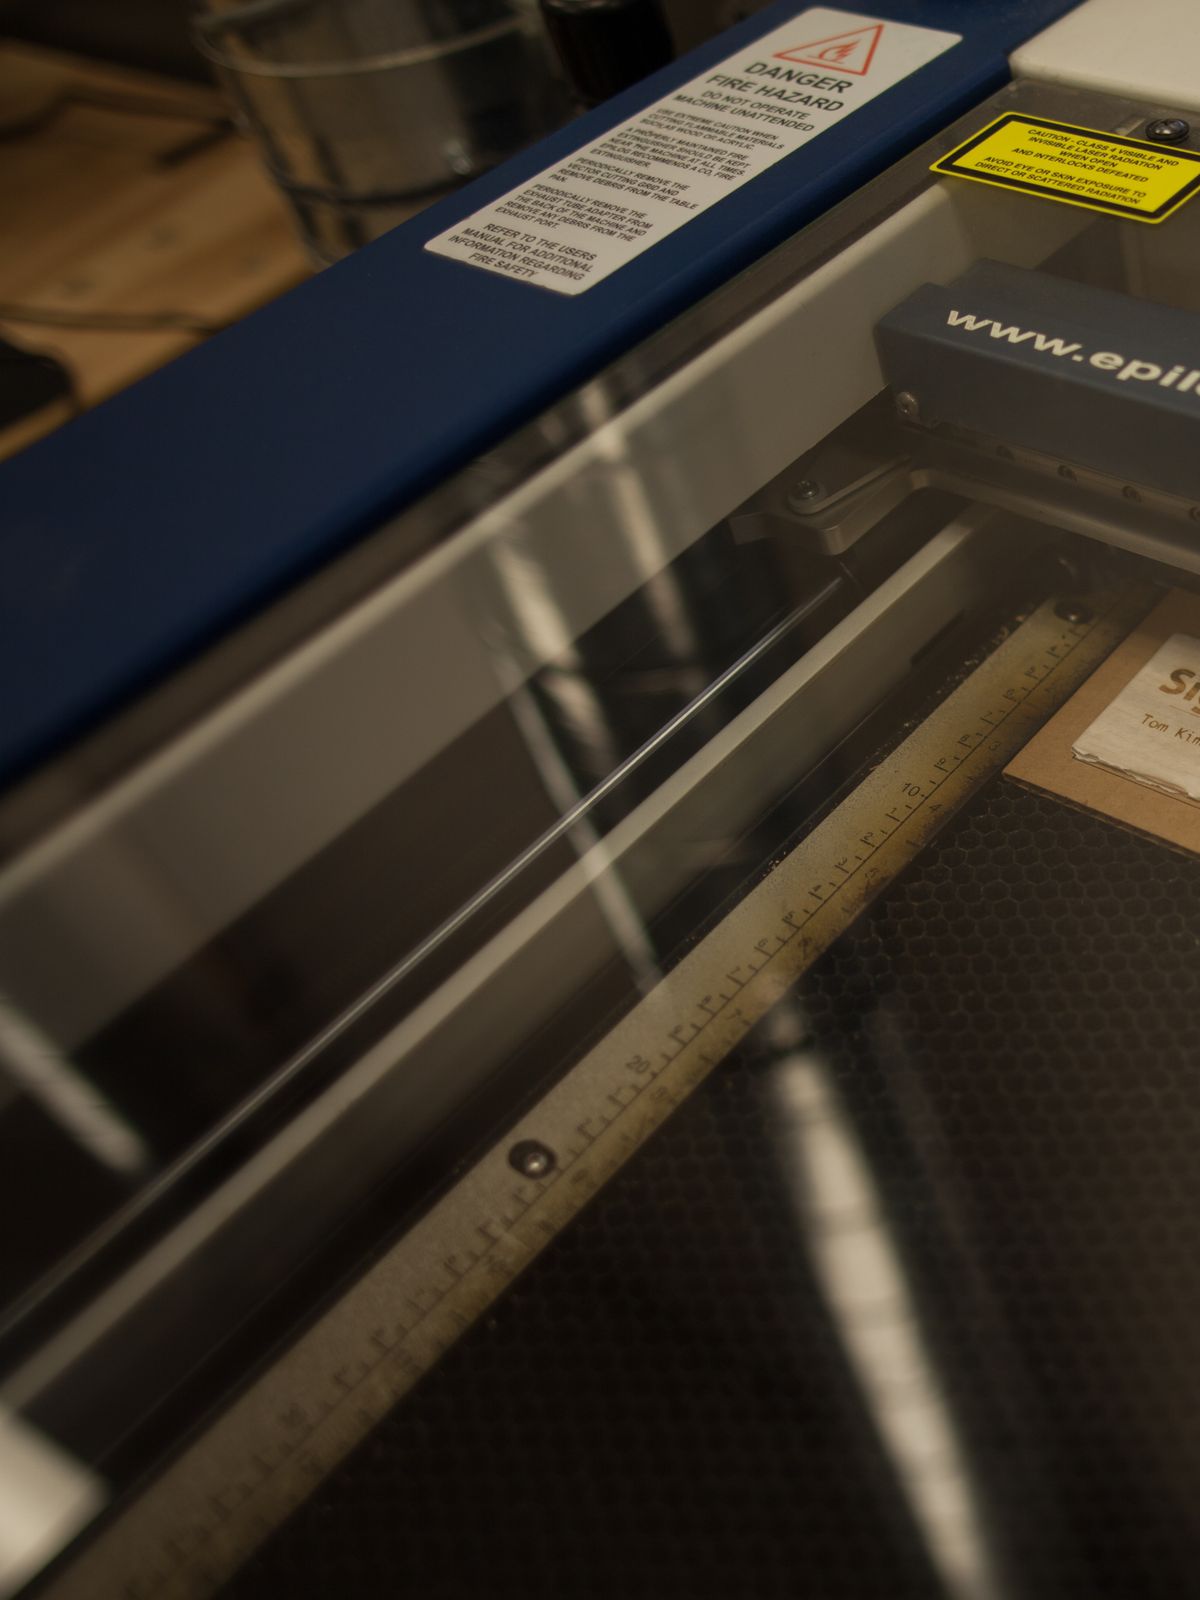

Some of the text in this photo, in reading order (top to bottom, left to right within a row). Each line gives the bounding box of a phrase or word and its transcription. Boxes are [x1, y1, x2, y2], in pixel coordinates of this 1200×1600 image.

[706, 74, 844, 111] FIRE HAZARD
[744, 62, 853, 94] DANGER
[673, 94, 815, 132] MACHINE UNATTENDED
[701, 90, 810, 120] DO NOT OPERATE
[648, 113, 785, 149] CUTTING FLAMMABLE MATERIALS
[674, 112, 713, 125] EXTREME
[713, 121, 752, 134] CAUTION
[751, 130, 778, 141] WHEN
[676, 127, 704, 137] WOOD
[702, 133, 718, 141] OR
[599, 142, 632, 154] EPILOG
[630, 150, 691, 169] RECOMMENDS
[713, 171, 736, 181] FIRE
[608, 137, 633, 147] NEAR
[633, 143, 650, 151] THE
[649, 147, 688, 161] MACHINE
[699, 160, 716, 169] ALL
[617, 132, 751, 169] EXTINGUISHER SHOULD BE KEPT
[633, 128, 676, 143] PROPERLY
[676, 139, 728, 155] MAINTAINED
[726, 152, 749, 161] FIRE
[1027, 129, 1071, 142] CAUTION
[1076, 139, 1110, 151] CLASS
[1118, 148, 1157, 161] VISIBLE
[1156, 158, 1179, 166] AND
[1028, 136, 1163, 170] INVISIBLE LASER RADIATION
[1059, 150, 1118, 168] WHEN OPEN
[567, 162, 680, 196] VECTOR CUTTING GRID AND
[575, 157, 690, 191] PERIODICALLY REMOVE THE
[983, 156, 1014, 167] AVOID
[1013, 163, 1035, 172] EYE
[1050, 172, 1076, 181] SKIN
[1075, 177, 1131, 194] EXPOSURE
[1132, 190, 1147, 198] TO
[1012, 147, 1149, 182] AND INTERLOCKS DEFEATED
[558, 168, 699, 210] REMOVE DEBRIS FROM THE TABLE
[974, 161, 1141, 204] DIRECT OR SCATTERED RADIATION
[494, 206, 536, 221] EXHAUST
[514, 194, 533, 204] THE
[530, 199, 558, 211] BACK
[569, 210, 588, 220] THE
[586, 215, 627, 231] MACHINE
[625, 227, 647, 236] AND
[523, 189, 653, 229] EXHAUST TUBE ADAPTER FROM
[532, 183, 647, 219] PERIODICALLY REMOVE THE
[504, 200, 636, 242] REMOVE ANY DEBRIS FROM THE
[448, 234, 585, 281] INFORMATION REGARDING
[461, 227, 593, 273] MANUAL FOR ADDITIONAL
[483, 223, 597, 261] REFER TO THE USERS
[468, 252, 538, 278] FIRE SAFETY
[1141, 713, 1169, 733] Tom
[900, 781, 920, 798] 10
[625, 1055, 651, 1074] 20
